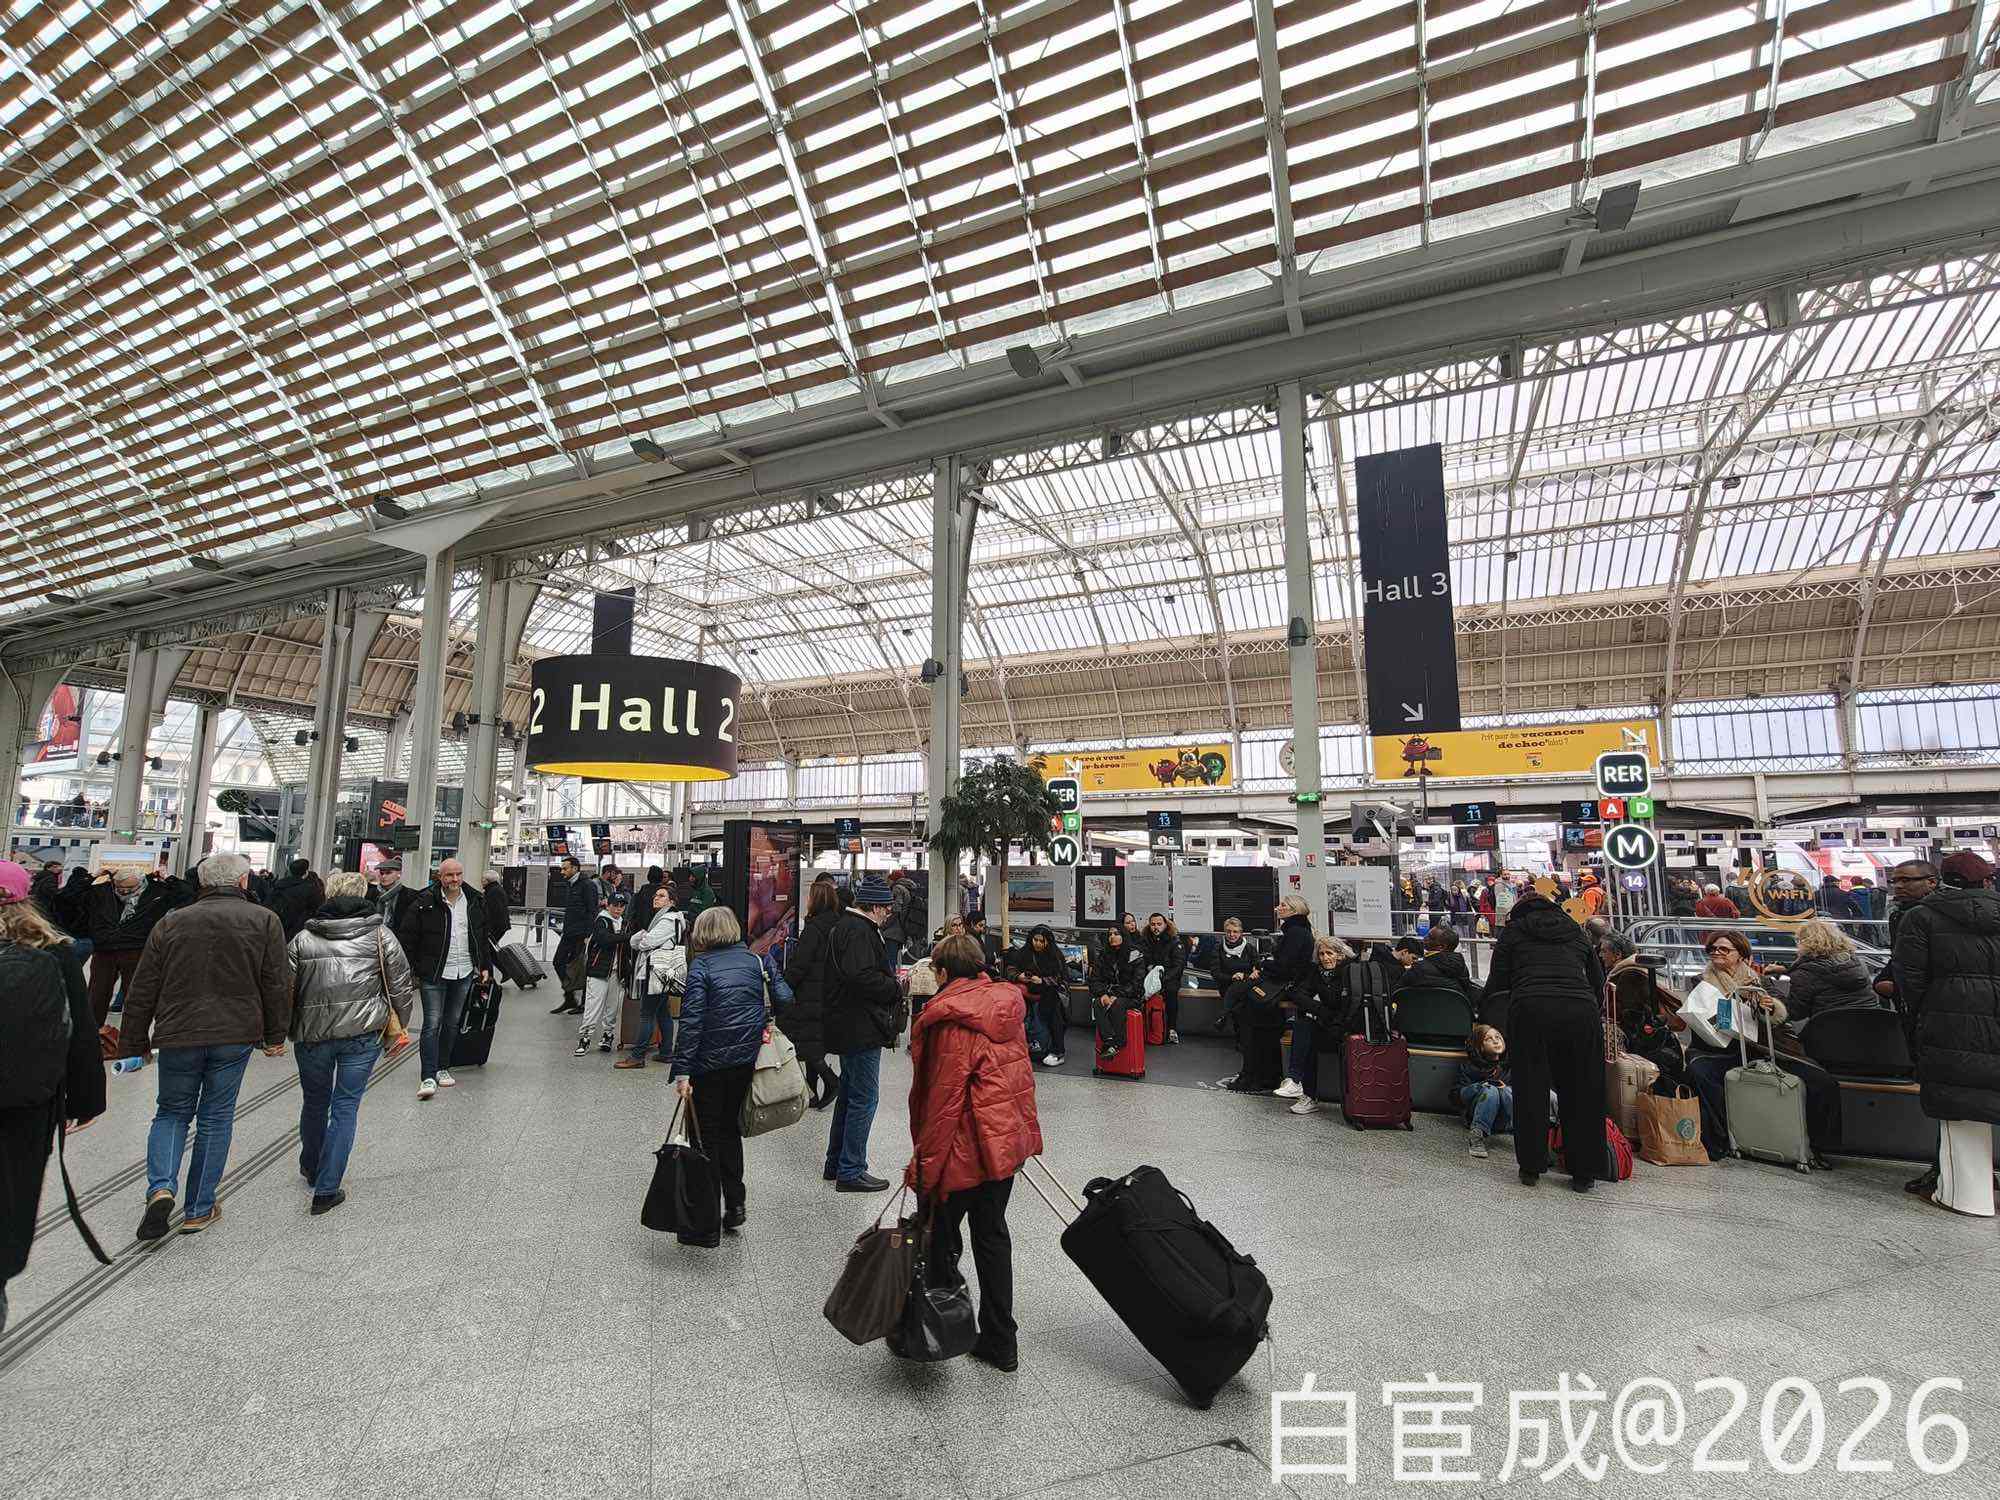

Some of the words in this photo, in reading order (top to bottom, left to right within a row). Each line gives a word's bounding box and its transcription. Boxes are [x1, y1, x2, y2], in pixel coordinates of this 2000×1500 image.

[1362, 575, 1423, 604] Hall
[1431, 572, 1448, 596] 3
[530, 687, 545, 735] 2
[570, 683, 700, 736] Hall
[718, 697, 735, 744] 2
[1521, 728, 1585, 738] vacances
[1498, 741, 1513, 749] de
[1604, 765, 1643, 783] RER
[1466, 809, 1481, 819] 11
[1582, 806, 1591, 817] 9
[1606, 803, 1618, 815] A
[1636, 802, 1648, 813] D
[843, 822, 852, 830] 17
[1068, 817, 1077, 828] D
[1159, 816, 1171, 825] 13
[1616, 834, 1645, 859] M
[1054, 843, 1072, 863] M
[1624, 876, 1644, 888] 14
